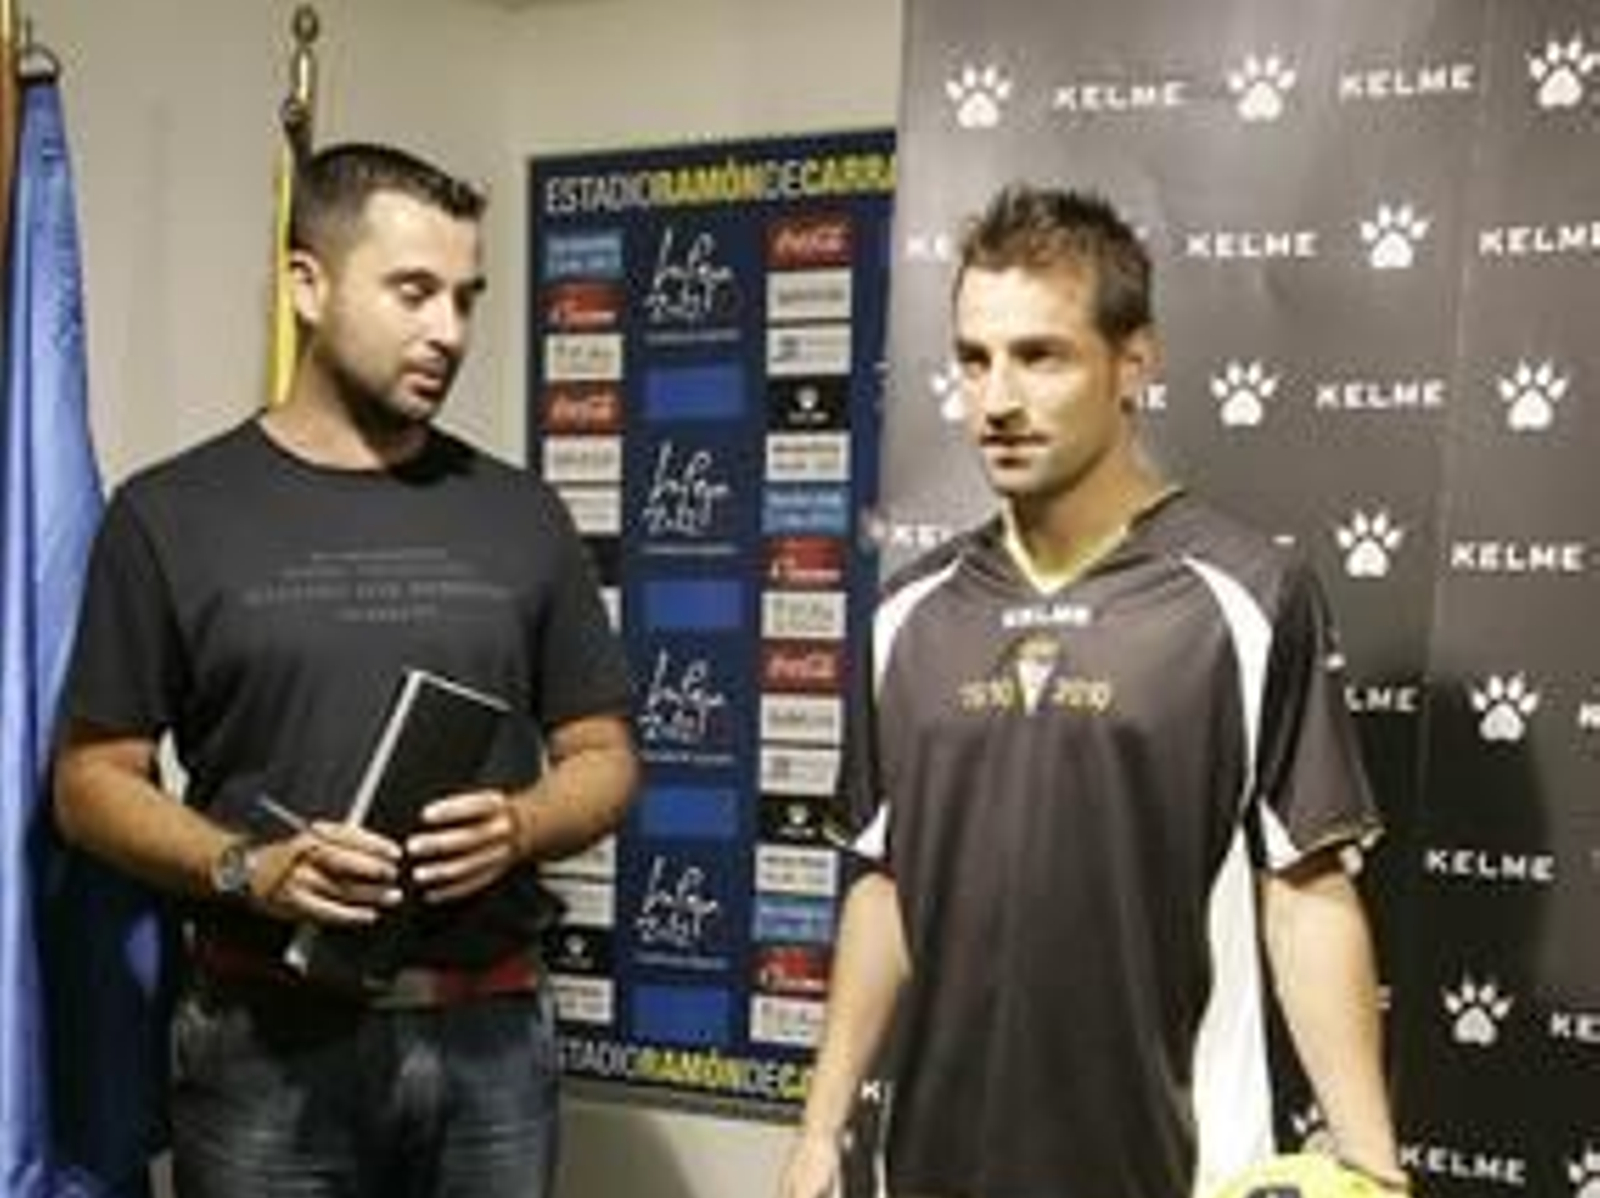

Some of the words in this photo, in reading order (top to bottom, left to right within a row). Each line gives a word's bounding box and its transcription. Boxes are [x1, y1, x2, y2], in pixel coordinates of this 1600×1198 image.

[1053, 81, 1187, 111] KELME
[1338, 65, 1474, 101] KELME
[1187, 231, 1317, 259] KELME
[1316, 379, 1445, 409] KELME
[1451, 542, 1584, 572] KELME
[1002, 604, 1091, 628] KELME
[1343, 686, 1417, 712] LME
[1426, 849, 1555, 882] KELME
[1400, 1145, 1526, 1187] KELME
